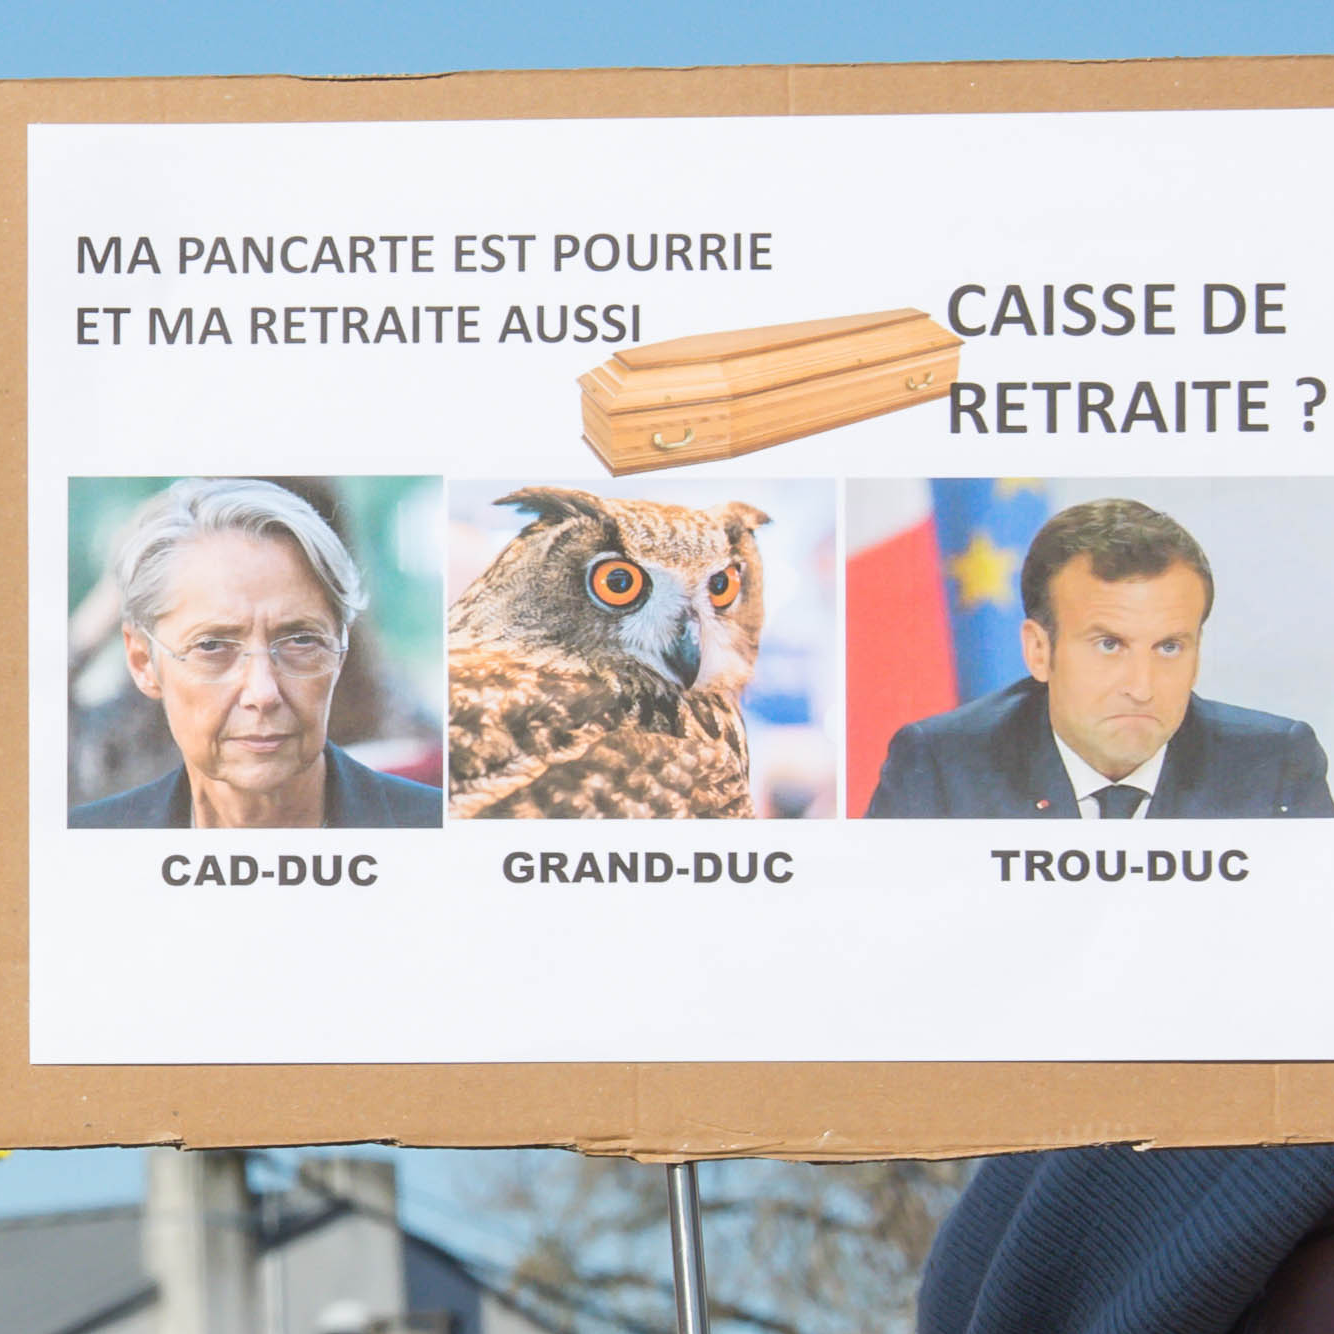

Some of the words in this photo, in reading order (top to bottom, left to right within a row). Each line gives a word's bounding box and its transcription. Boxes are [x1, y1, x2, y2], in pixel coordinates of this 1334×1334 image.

[76, 235, 162, 275] MA
[178, 234, 435, 276] PANCARTE
[453, 233, 536, 274] EST
[553, 232, 773, 272] POURRIE
[76, 307, 132, 346] ET
[148, 306, 233, 346] MA
[249, 305, 481, 346] RETRAITE
[497, 304, 642, 344] AUSSI
[947, 283, 1176, 337] CAISSE
[1202, 282, 1287, 335] DE
[949, 380, 1269, 434] RETRAITE
[1295, 376, 1327, 433] ?
[160, 853, 379, 888] CAD-DUC
[501, 850, 795, 885] GRAND-DUC
[989, 848, 1250, 883] TROU-DUC
